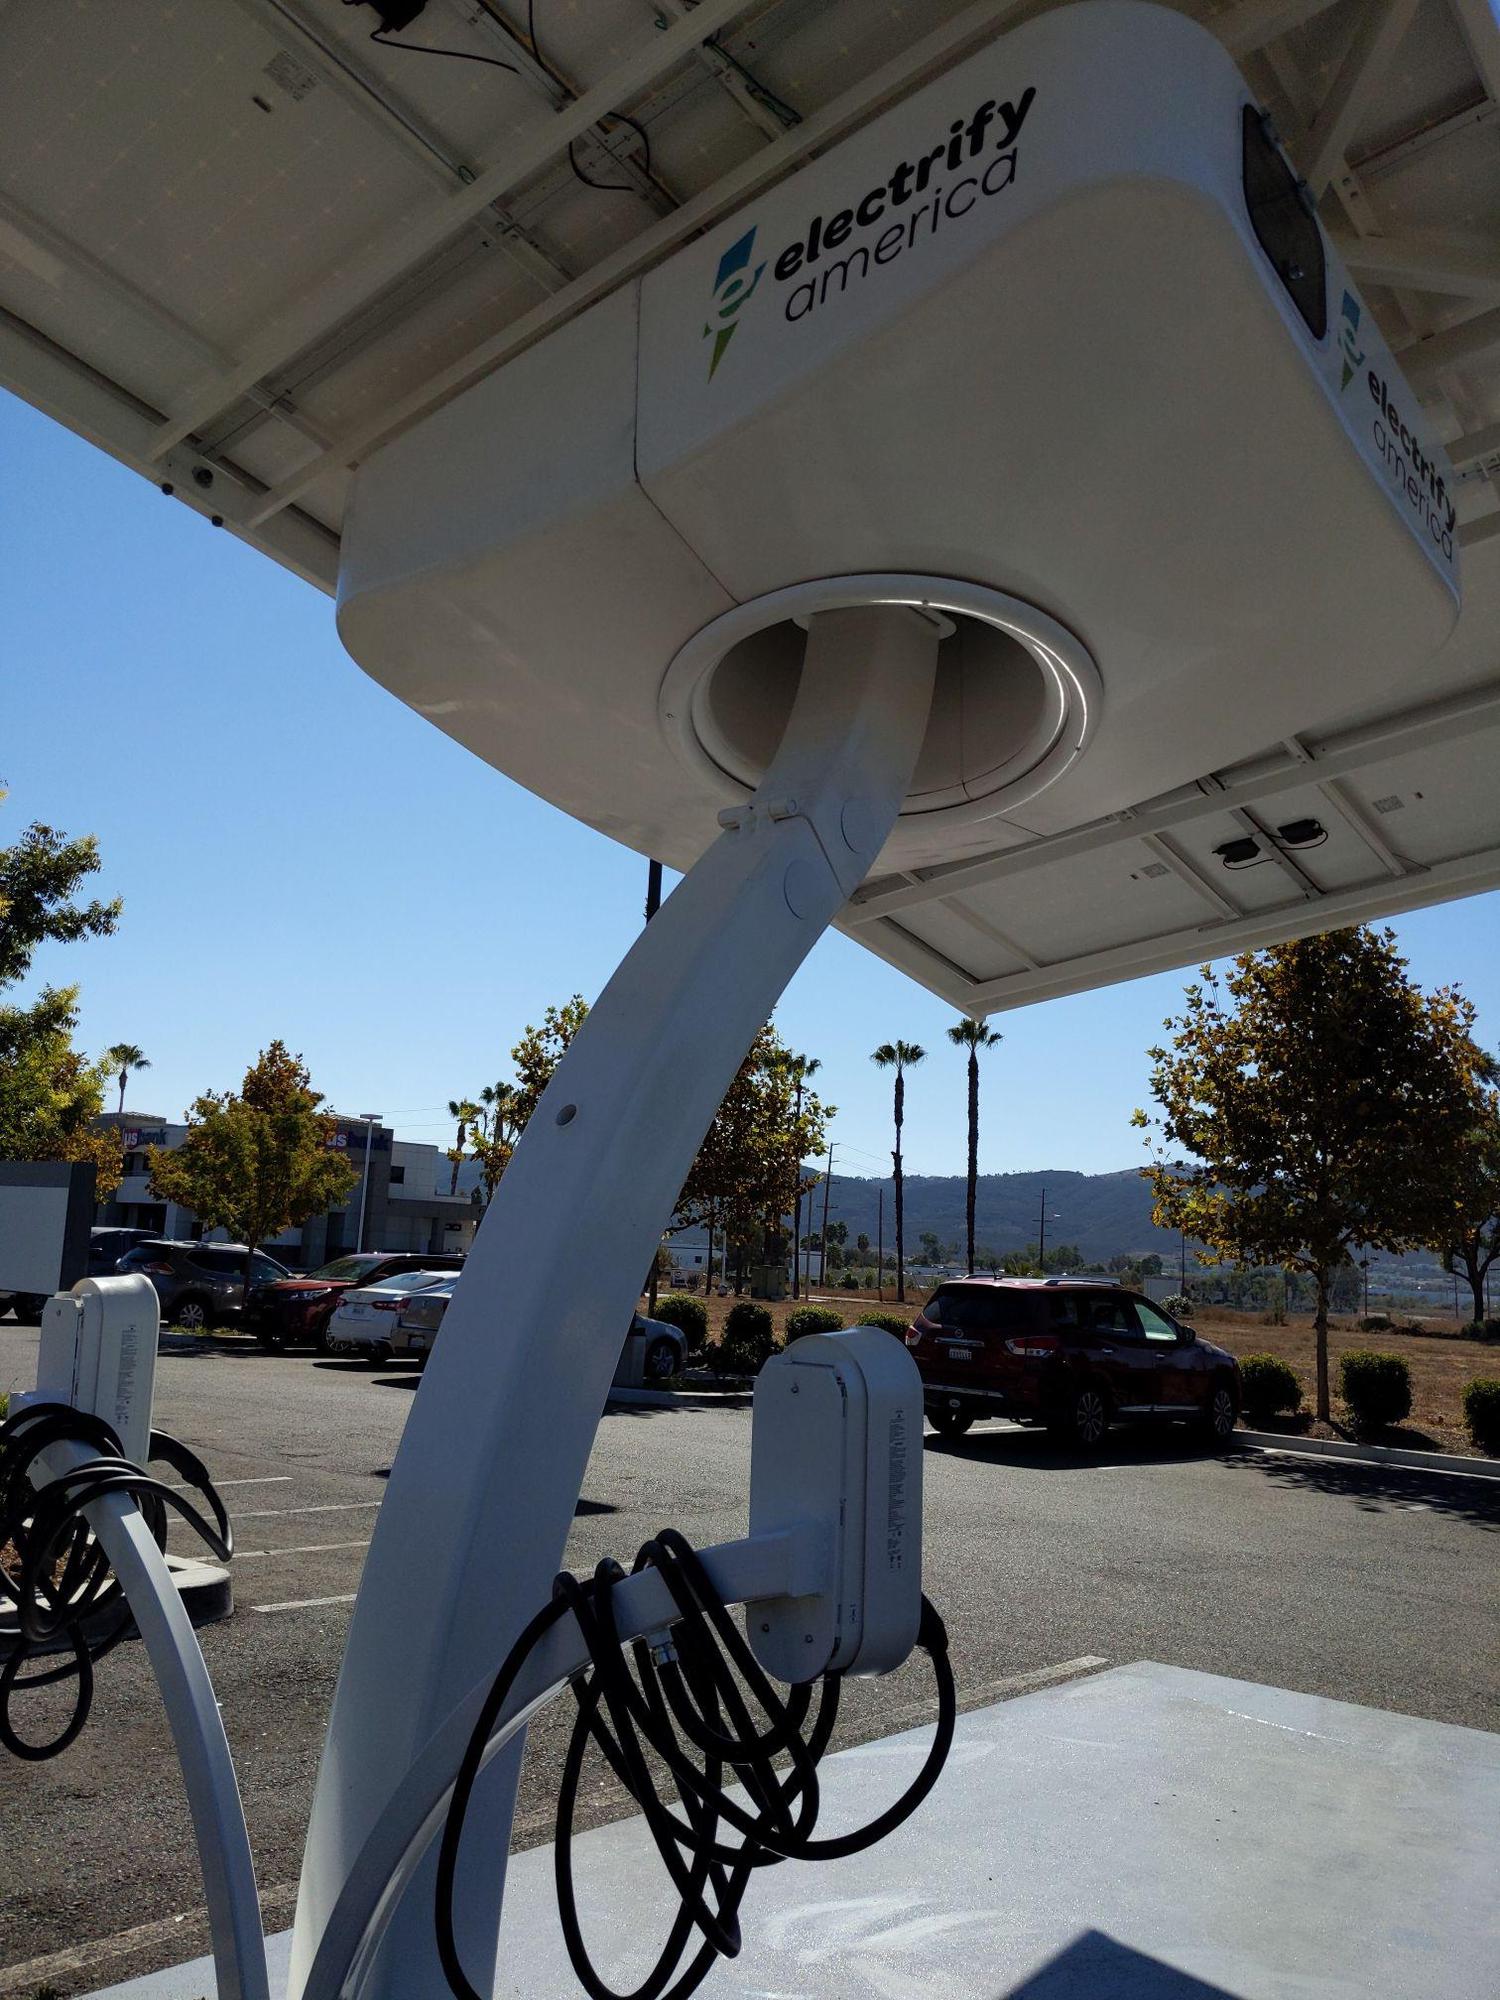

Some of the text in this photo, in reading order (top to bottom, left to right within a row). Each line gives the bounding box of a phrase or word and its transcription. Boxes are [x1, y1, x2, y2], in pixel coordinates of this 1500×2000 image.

[774, 86, 1036, 281] electrify
[785, 147, 1018, 322] america
[1367, 370, 1456, 534] electrify
[1373, 420, 1453, 564] america
